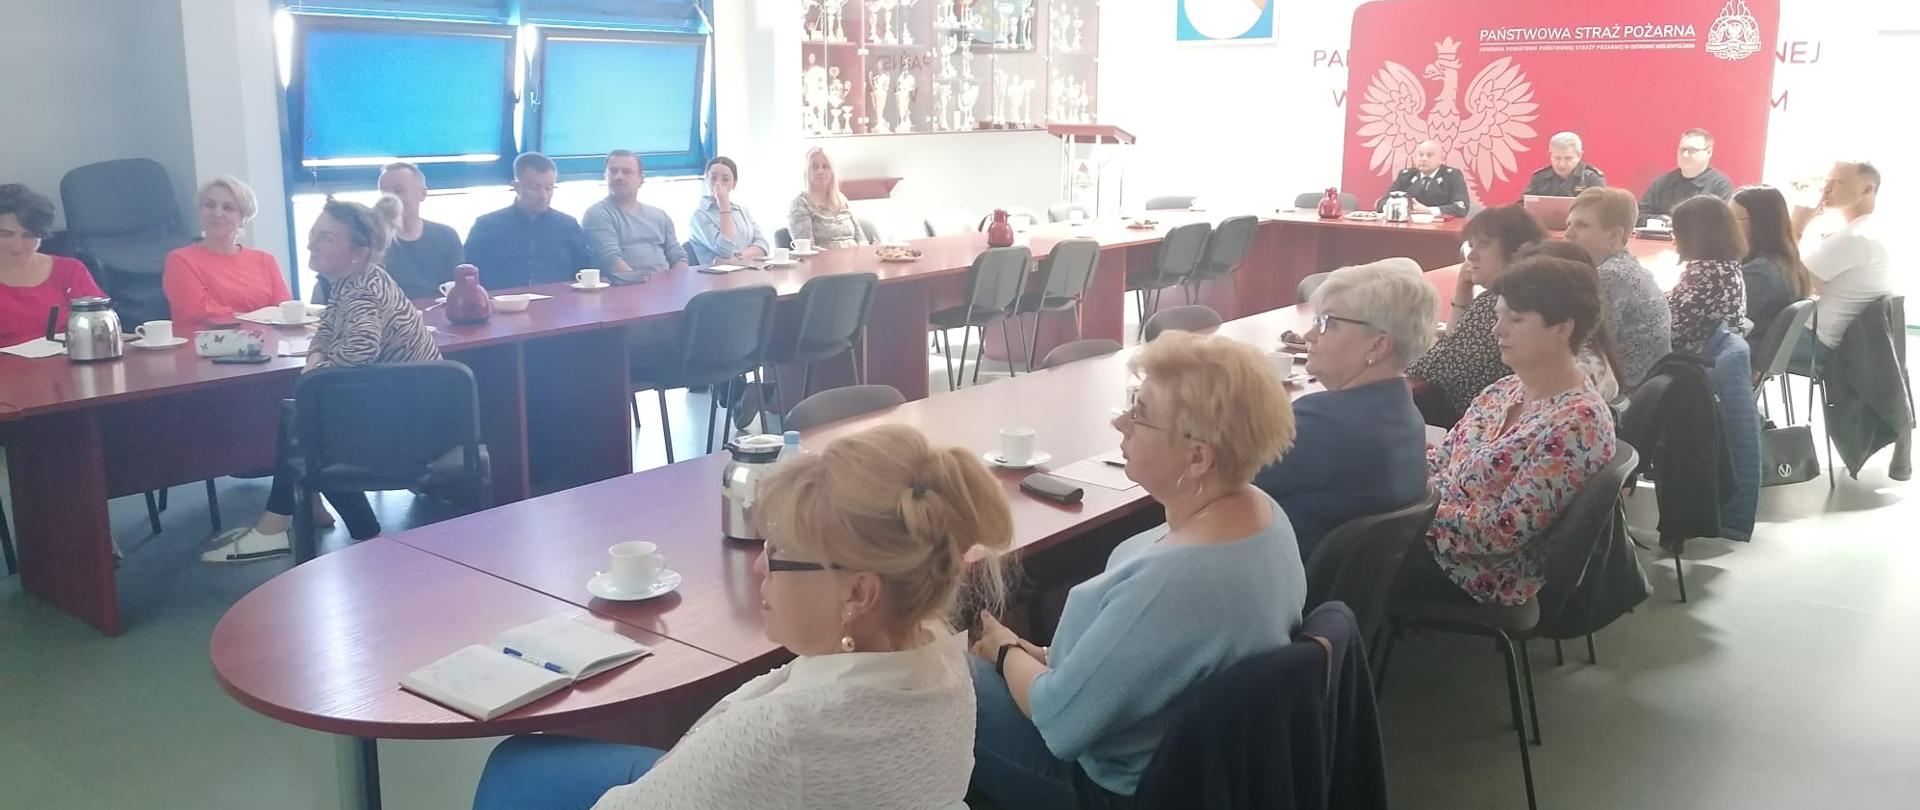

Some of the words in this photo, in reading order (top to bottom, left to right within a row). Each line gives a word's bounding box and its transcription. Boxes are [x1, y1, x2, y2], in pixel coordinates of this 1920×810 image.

[1480, 26, 1572, 40] PAŃSTWOWA
[1575, 23, 1620, 39] STRAŻ
[1624, 22, 1696, 38] POŻARNA
